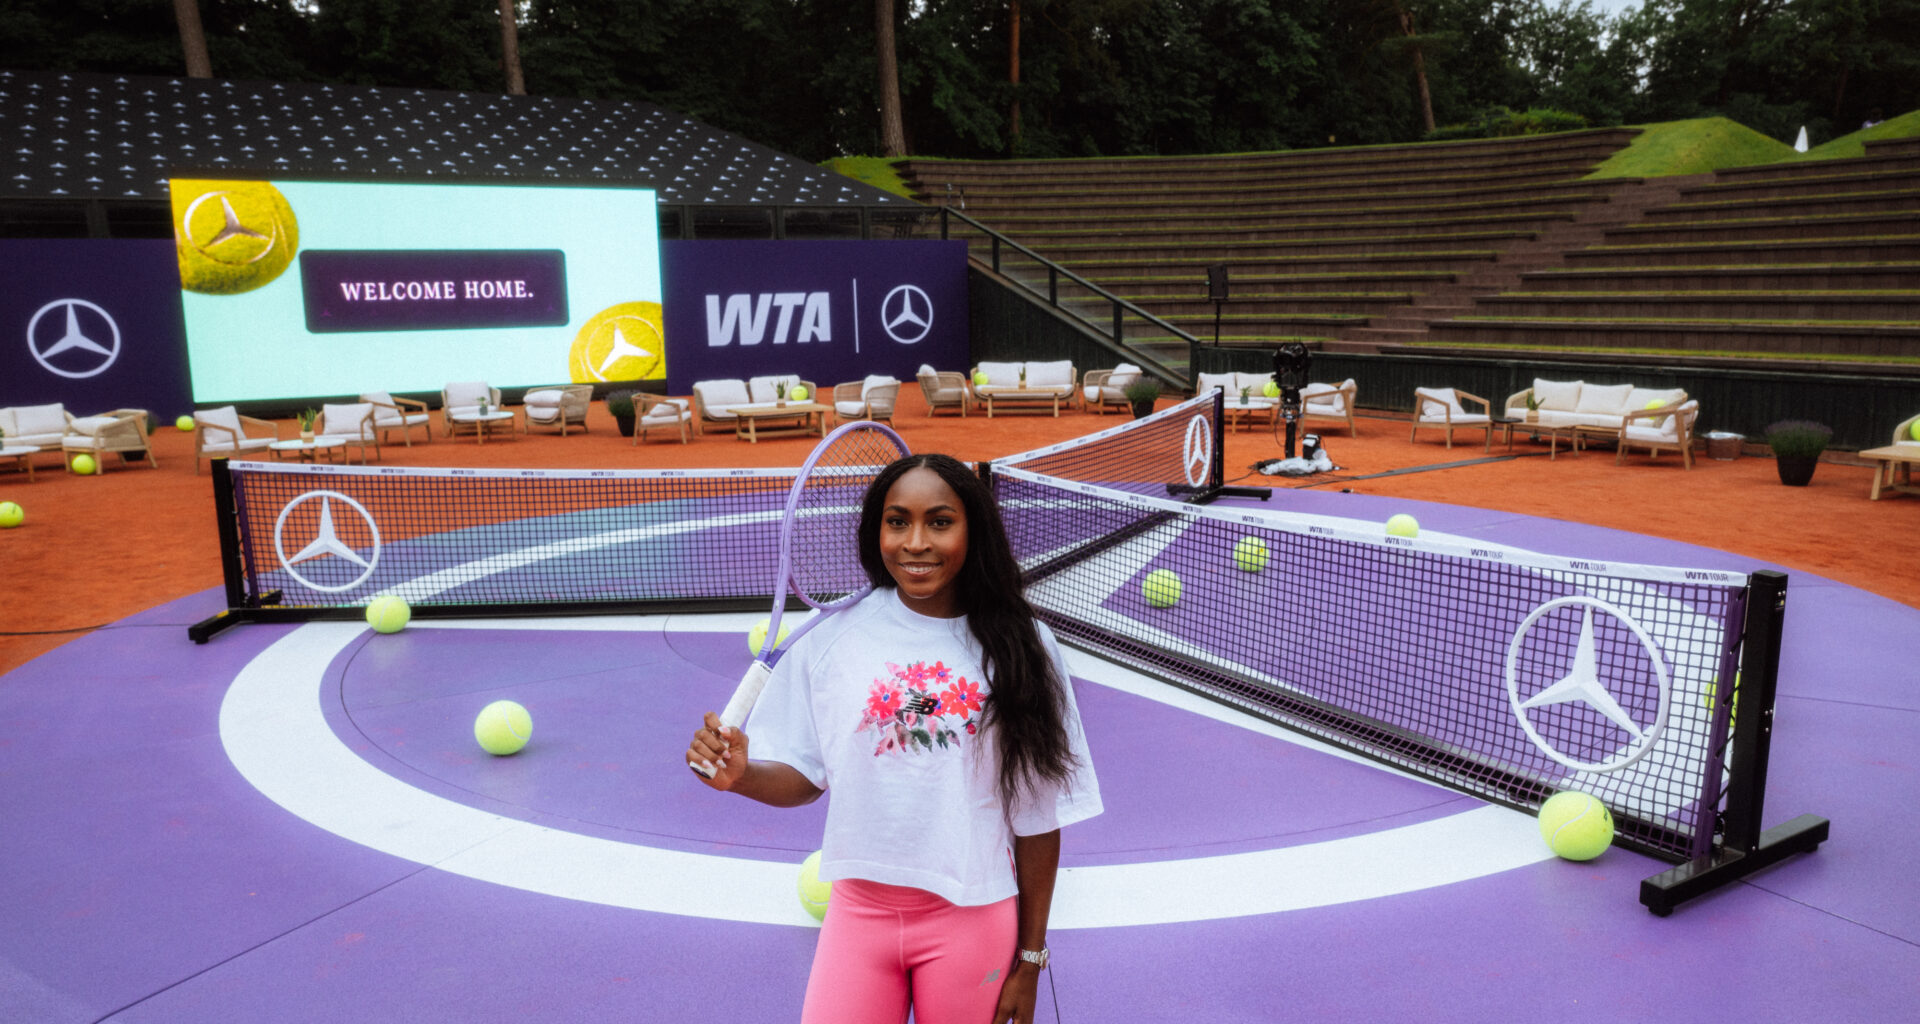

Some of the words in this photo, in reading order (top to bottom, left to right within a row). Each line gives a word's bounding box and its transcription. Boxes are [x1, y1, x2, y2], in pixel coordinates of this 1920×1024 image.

[340, 281, 456, 301] WELCOME
[464, 280, 534, 299] HOME.
[705, 292, 831, 346] WTA
[1384, 536, 1400, 545] WTA
[1470, 548, 1488, 557] WTA
[1569, 560, 1590, 571] WTA
[1590, 562, 1607, 572] TOUR
[1684, 571, 1709, 580] WTA
[1709, 573, 1729, 582] TOUR
